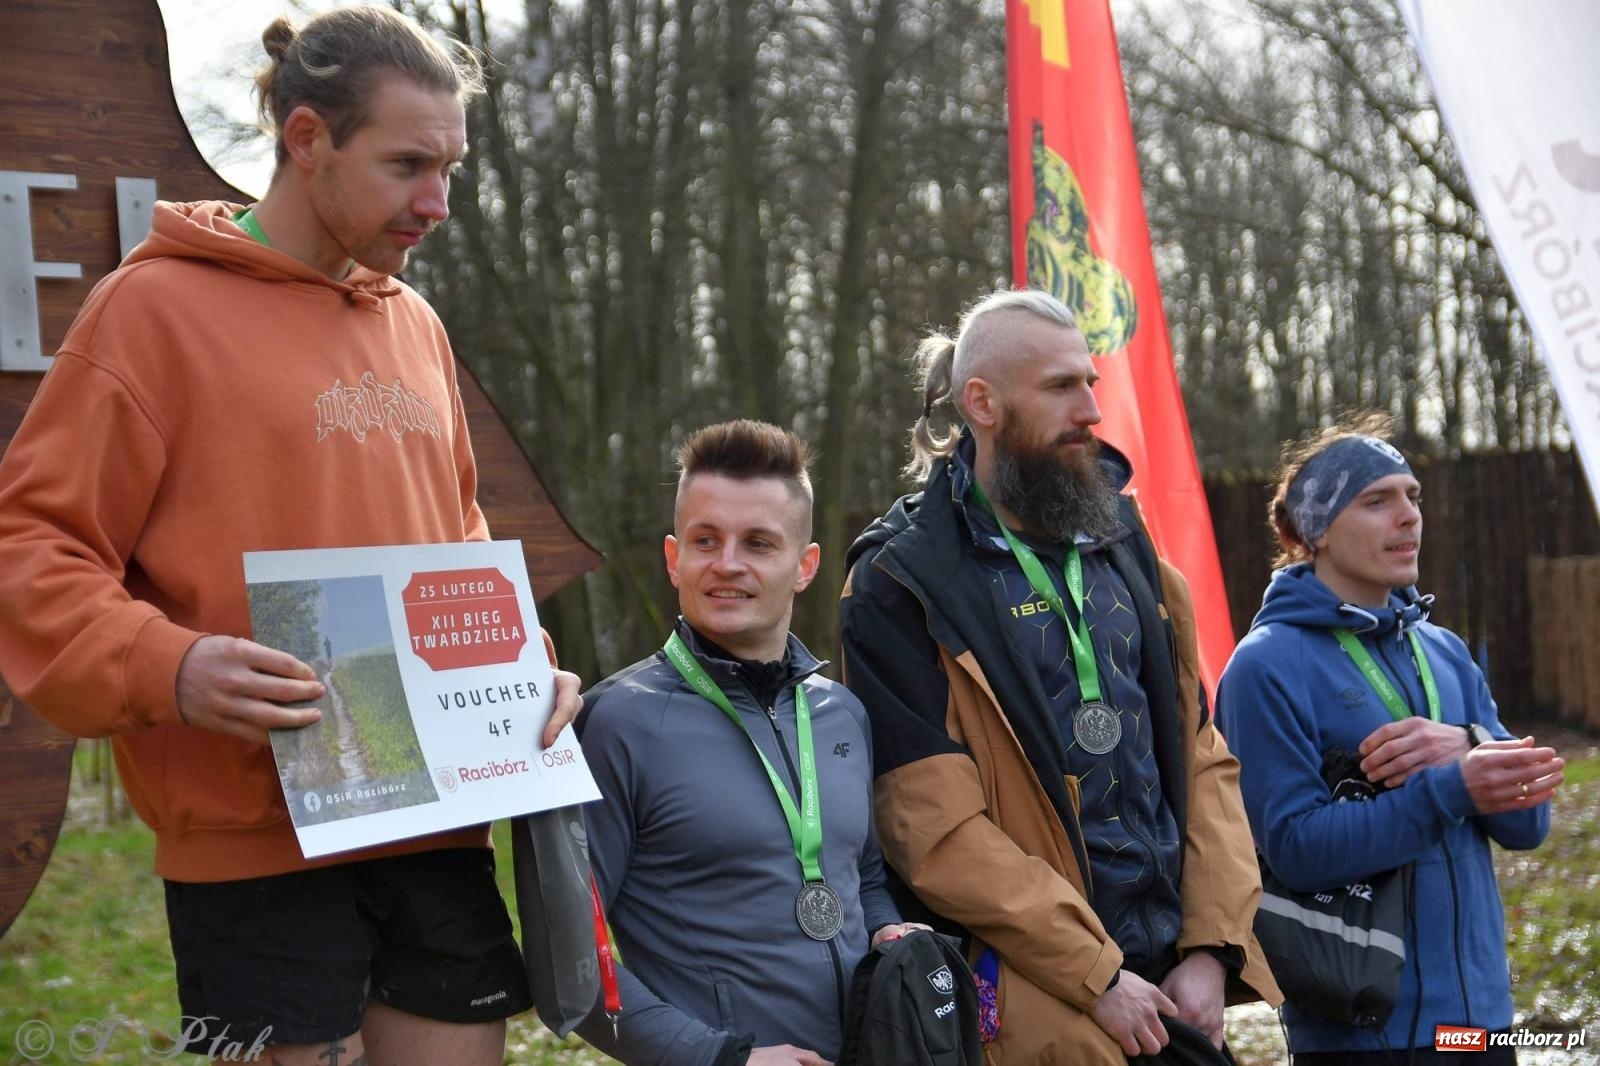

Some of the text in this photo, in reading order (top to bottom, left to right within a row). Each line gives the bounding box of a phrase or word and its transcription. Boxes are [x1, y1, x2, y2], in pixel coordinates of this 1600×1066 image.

[420, 580, 494, 598] 25 LUTEGO
[432, 610, 501, 630] XII BIEG
[412, 626, 521, 650] TWARDZIELA
[437, 682, 540, 711] VOUCHER
[489, 719, 512, 737] 4F
[833, 742, 850, 758] 4F
[458, 749, 576, 783] Racibórz OSiR
[326, 783, 407, 804] OSiR Racibórz
